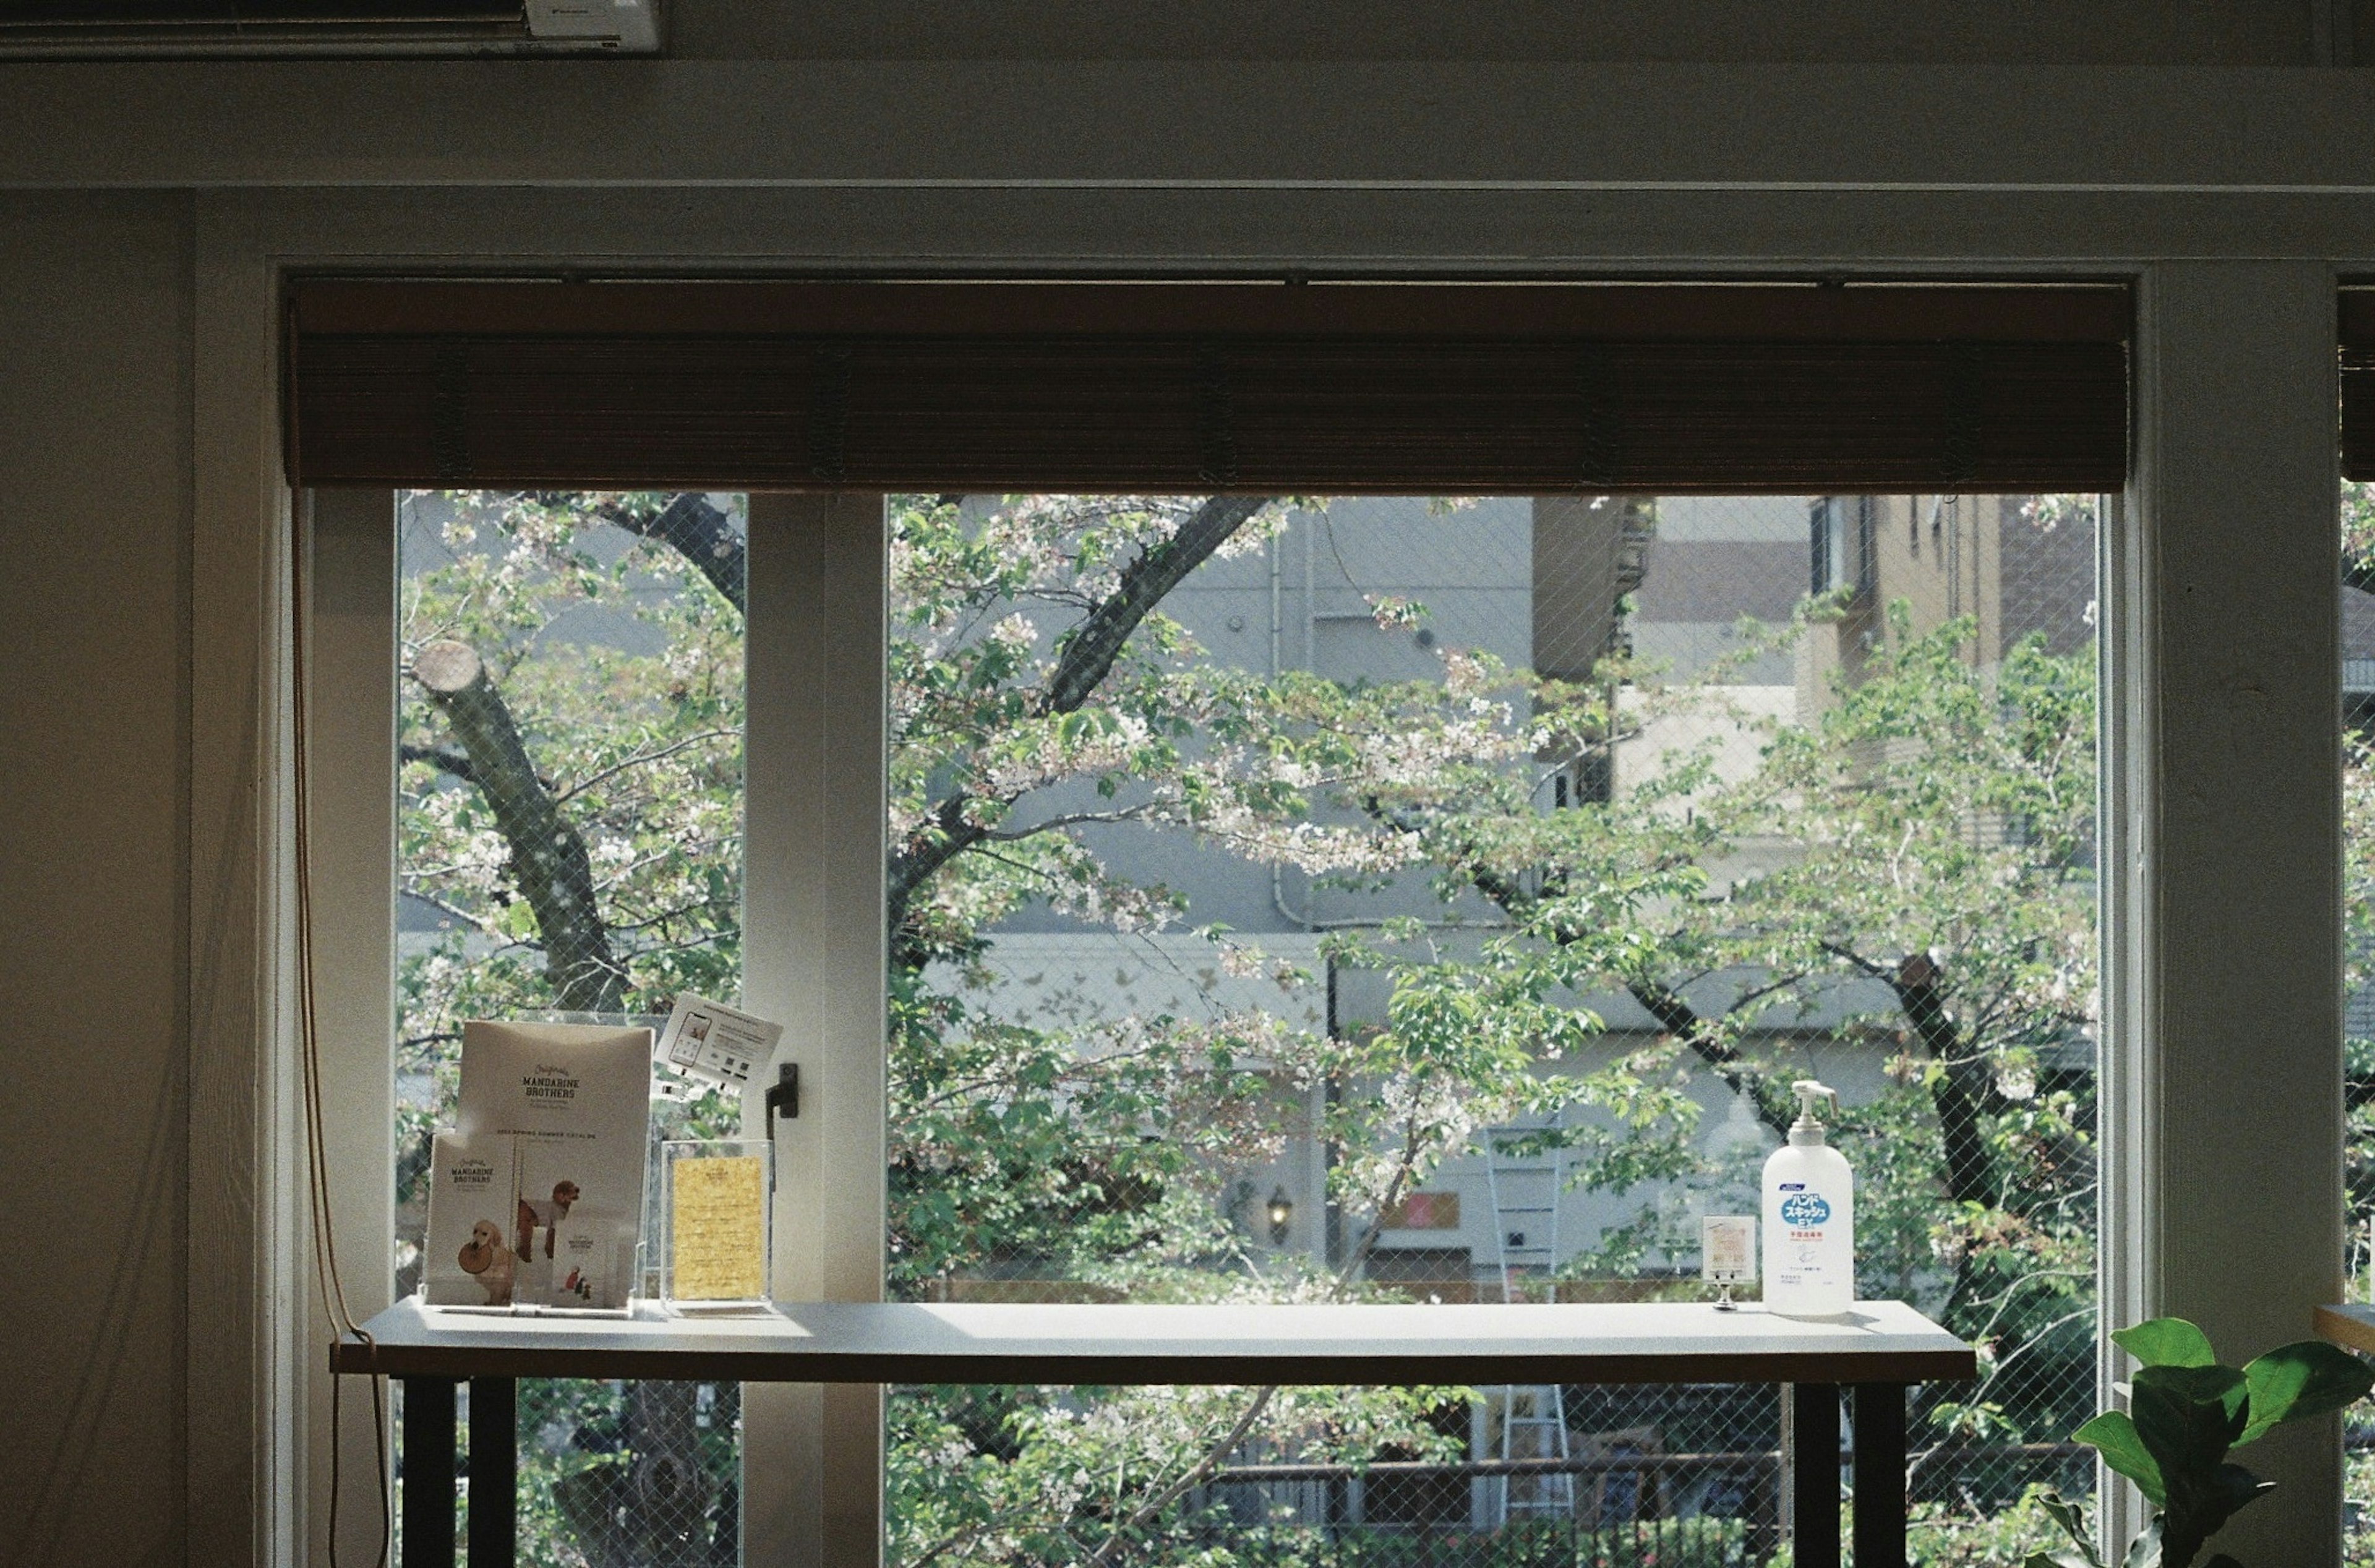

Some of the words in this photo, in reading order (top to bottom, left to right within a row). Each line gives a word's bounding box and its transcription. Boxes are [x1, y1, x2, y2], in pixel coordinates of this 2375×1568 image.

[523, 1076, 580, 1088] MANDARINE
[526, 1087, 575, 1098] BROTHERS
[452, 1167, 494, 1175] MANDARINE
[1791, 1194, 1820, 1206] ハンド
[1784, 1206, 1827, 1218] スキッシュ
[1798, 1218, 1814, 1229] EX
